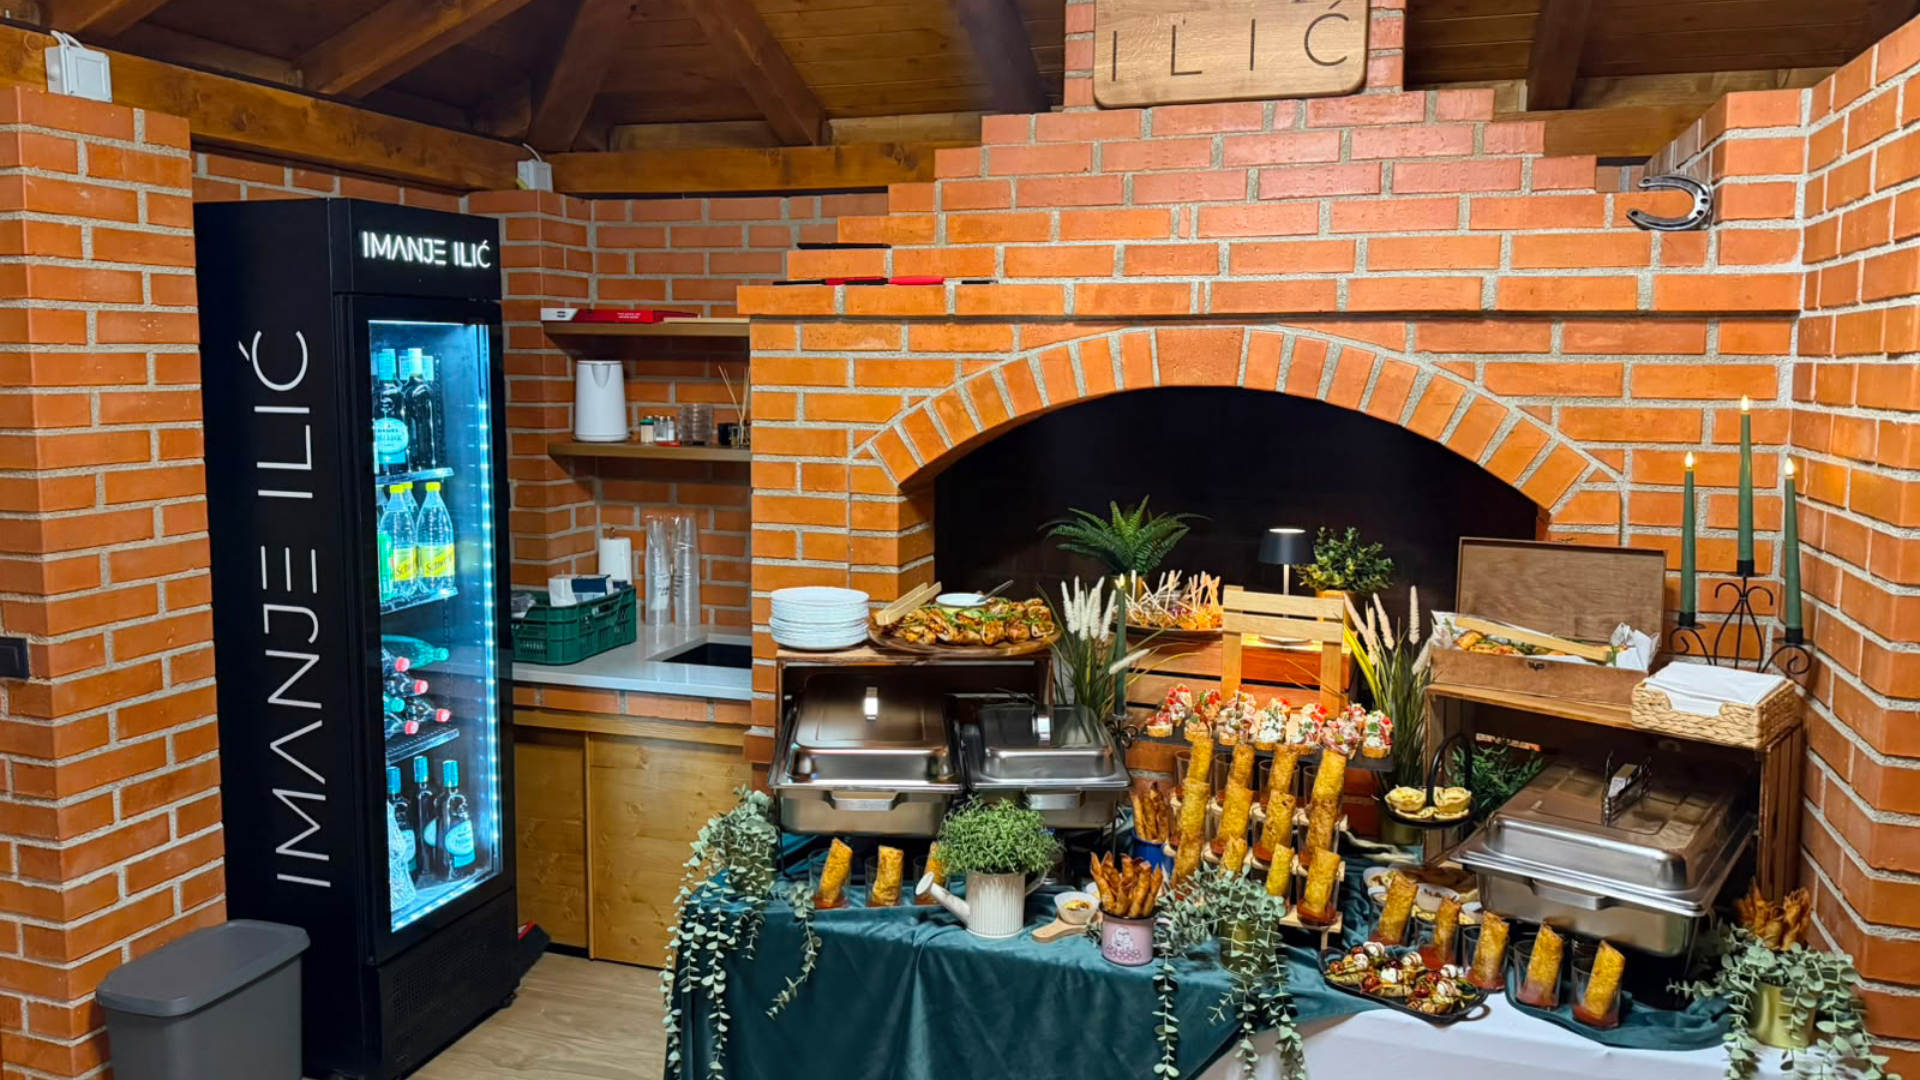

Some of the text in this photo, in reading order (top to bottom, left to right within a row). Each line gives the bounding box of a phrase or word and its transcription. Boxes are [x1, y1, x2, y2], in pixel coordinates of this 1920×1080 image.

[1111, 0, 1350, 82] ILIĆ
[362, 230, 491, 268] IMANJE ILIĆ
[238, 330, 331, 888] IMANJE ILIĆ
